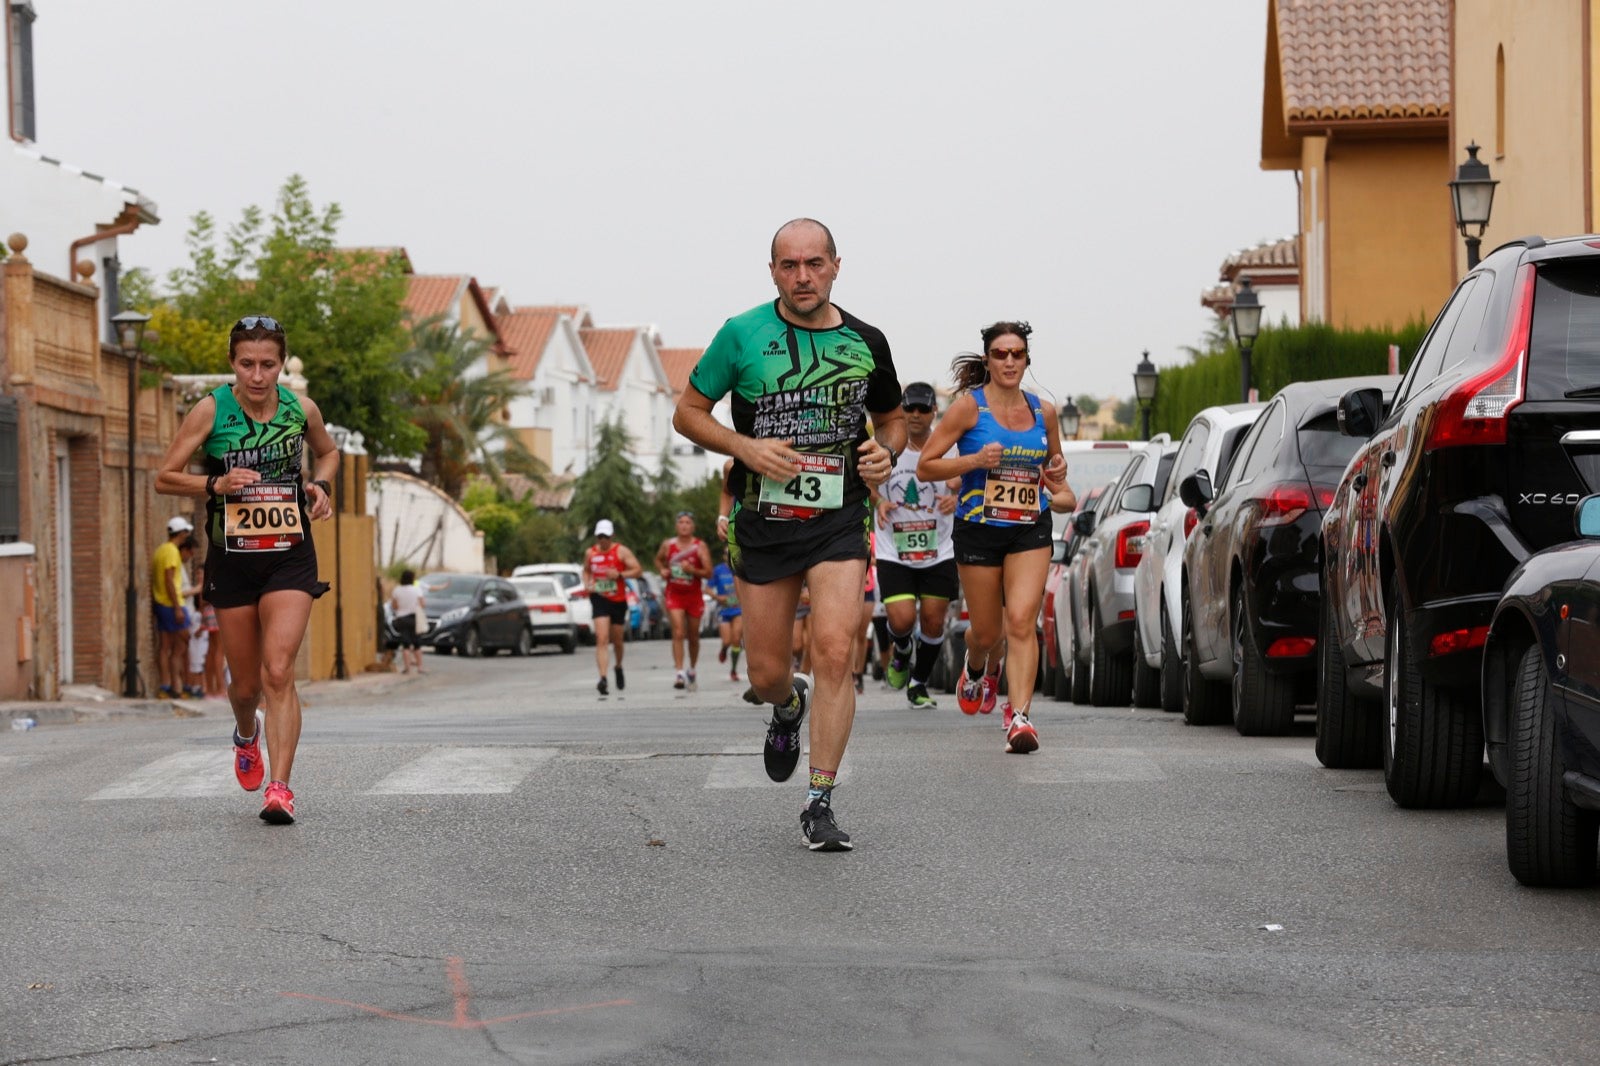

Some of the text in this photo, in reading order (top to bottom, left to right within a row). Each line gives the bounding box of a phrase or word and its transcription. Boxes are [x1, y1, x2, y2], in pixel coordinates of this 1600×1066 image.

[755, 391, 801, 414] TEAM
[784, 475, 821, 502] 43
[993, 484, 1036, 505] 2109
[237, 507, 297, 529] 2006
[907, 533, 928, 548] 59
